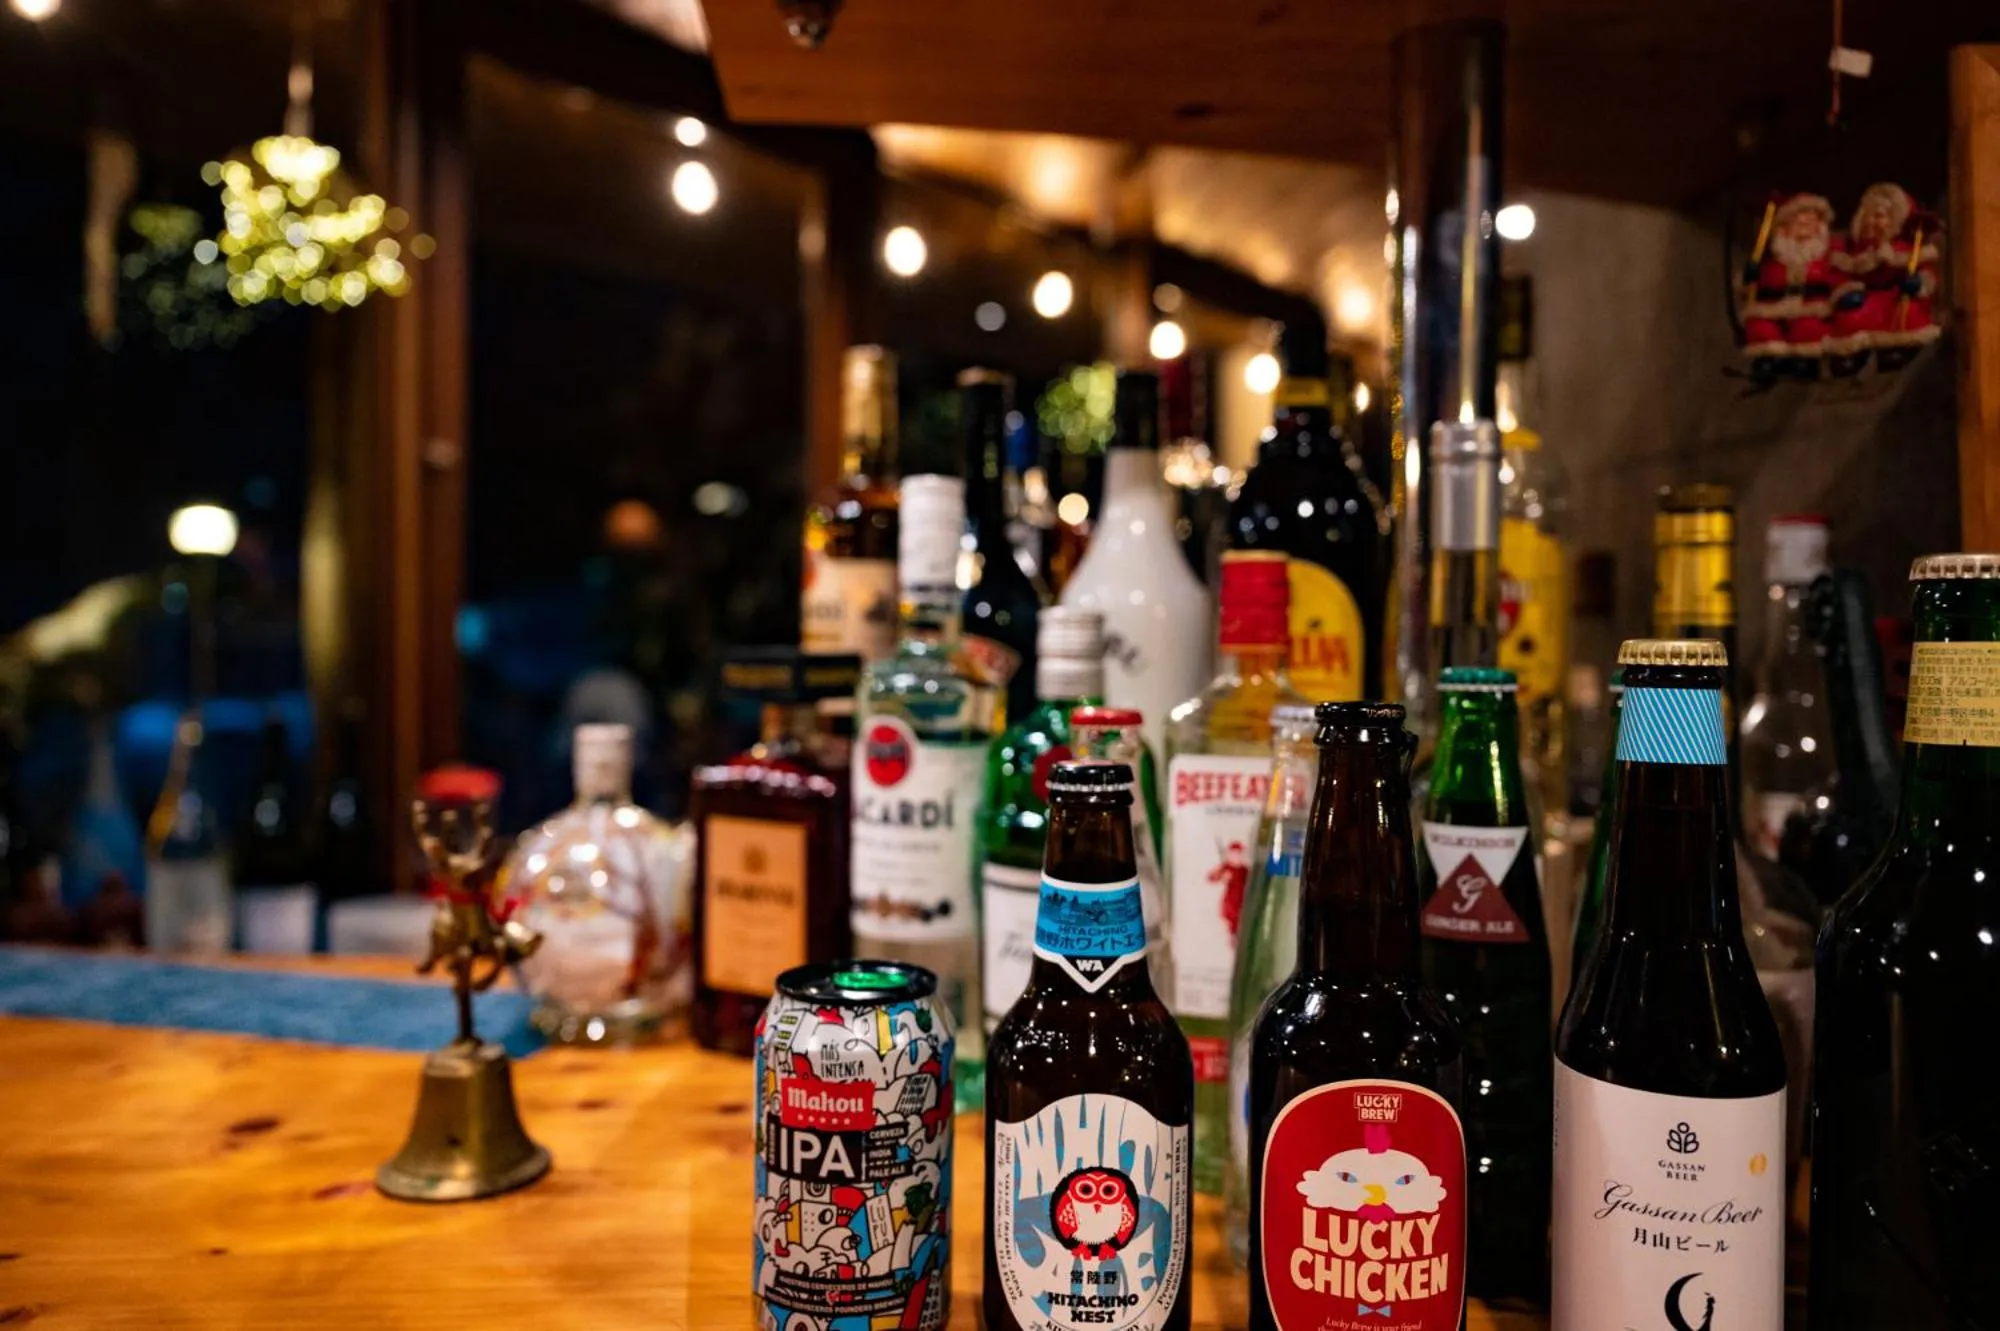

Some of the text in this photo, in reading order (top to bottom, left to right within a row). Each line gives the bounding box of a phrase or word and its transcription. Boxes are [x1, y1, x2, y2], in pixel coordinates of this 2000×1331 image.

[1425, 913, 1515, 933] GINGER ALE
[821, 1059, 865, 1079] INTENSA
[787, 1087, 864, 1113] Mahou
[1356, 1095, 1399, 1108] LUCKY
[1360, 1108, 1396, 1120] BREW
[779, 1127, 855, 1179] IPA
[1658, 1159, 1706, 1172] GASSAN
[1666, 1171, 1698, 1182] BEER
[1594, 1179, 1763, 1225] Gassan Beer
[1303, 1207, 1441, 1261] LUCKY
[1633, 1227, 1730, 1253] 月山ビール
[1290, 1247, 1449, 1303] CHICKEN
[1047, 1292, 1139, 1308] HITACHINO
[1070, 1310, 1116, 1323] NEST
[1326, 1317, 1350, 1329] Lucky
[1350, 1321, 1372, 1331] Brew
